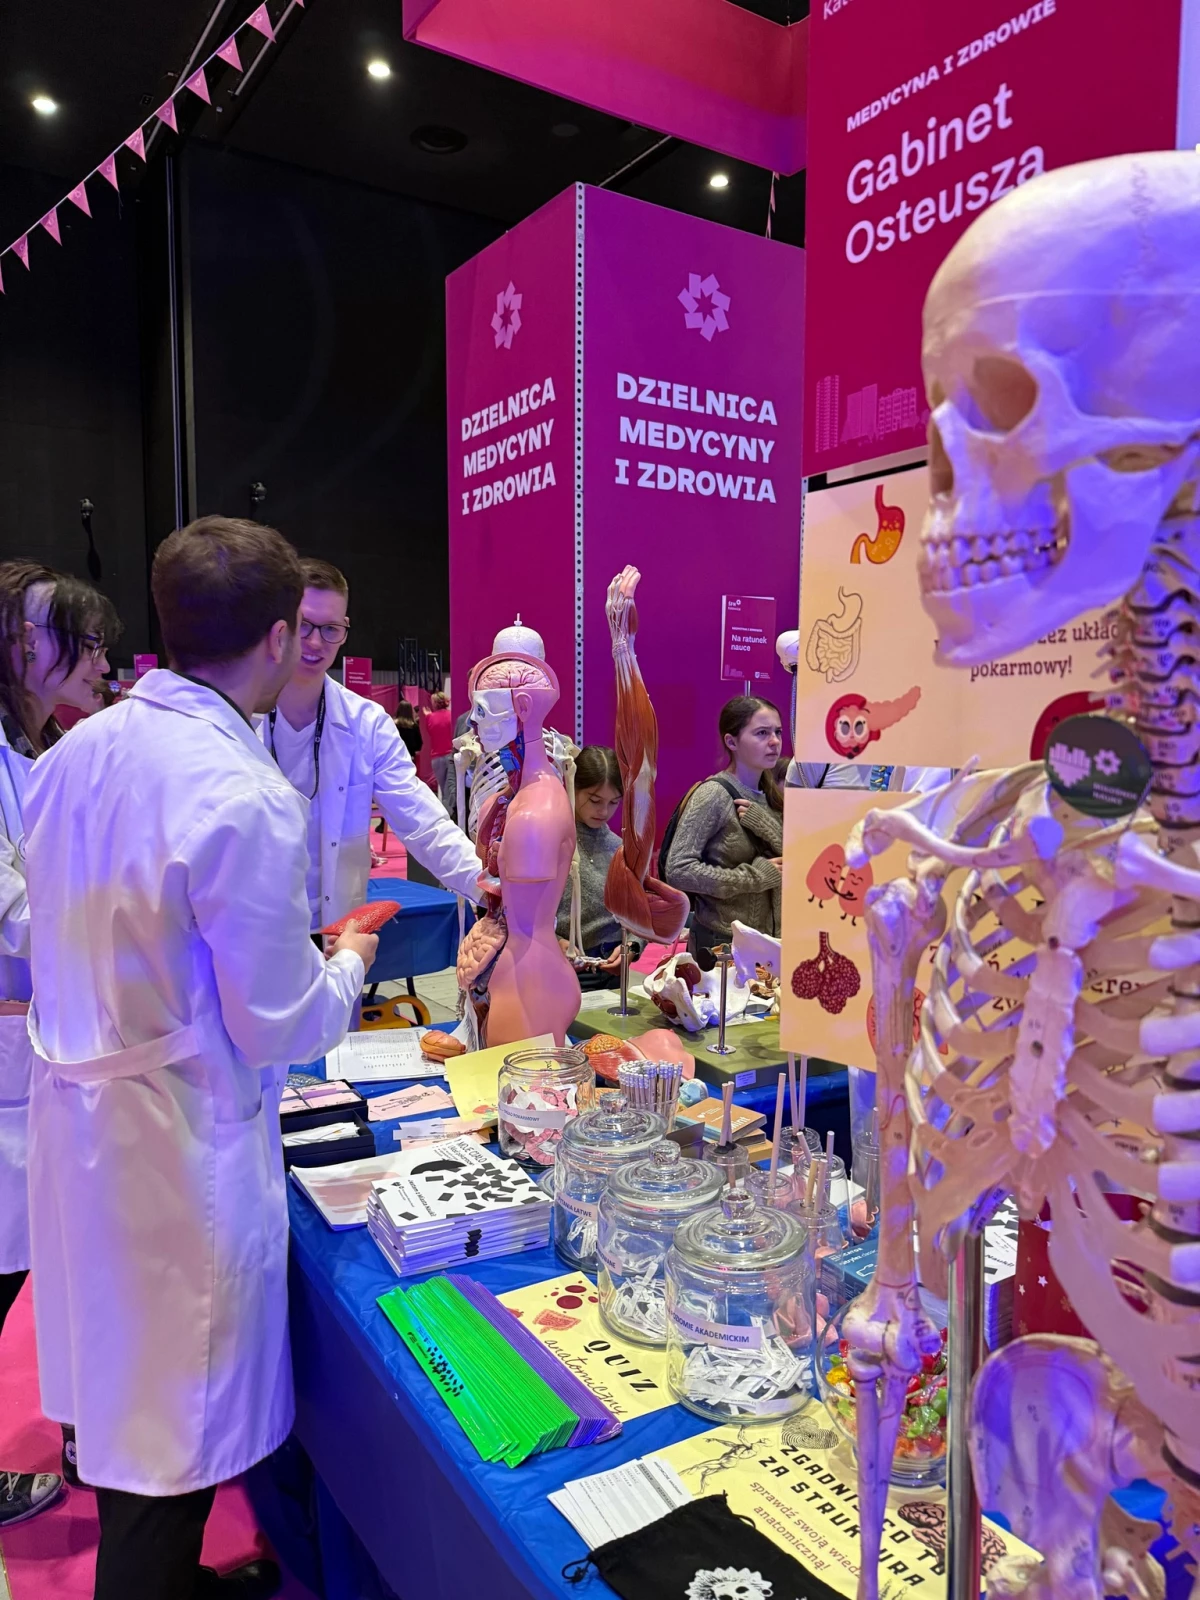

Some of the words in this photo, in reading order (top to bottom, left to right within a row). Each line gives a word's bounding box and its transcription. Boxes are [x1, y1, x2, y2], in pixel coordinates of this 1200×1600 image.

[846, 65, 940, 133] MEDYCYNA
[943, 55, 954, 76] I
[956, 0, 1057, 68] ZDROWIE
[846, 83, 1014, 205] Gabinet
[845, 145, 1046, 264] Osteusza
[461, 377, 556, 442] DZIELNICA
[617, 372, 778, 426] DZIELNICA
[463, 418, 554, 479] MEDYCYNY
[619, 416, 775, 464] MEDYCYNY
[461, 492, 470, 516] I
[472, 461, 556, 513] ZDROWIA
[615, 458, 630, 486] I
[637, 461, 777, 504] ZDROWIA
[731, 644, 751, 652] nauce
[732, 634, 741, 642] Na
[742, 635, 767, 644] ratunek
[970, 655, 1073, 682] pokarmowy!
[694, 1326, 750, 1343] AKADEMICKIM
[544, 1339, 628, 1416] anatomiczny
[583, 1340, 659, 1393] QUIZ
[758, 1456, 790, 1478] ZA
[750, 1481, 800, 1519] sprawdź
[794, 1518, 829, 1549] swoją
[829, 1547, 861, 1579] wiedz
[753, 1506, 832, 1571] anatomiczną!
